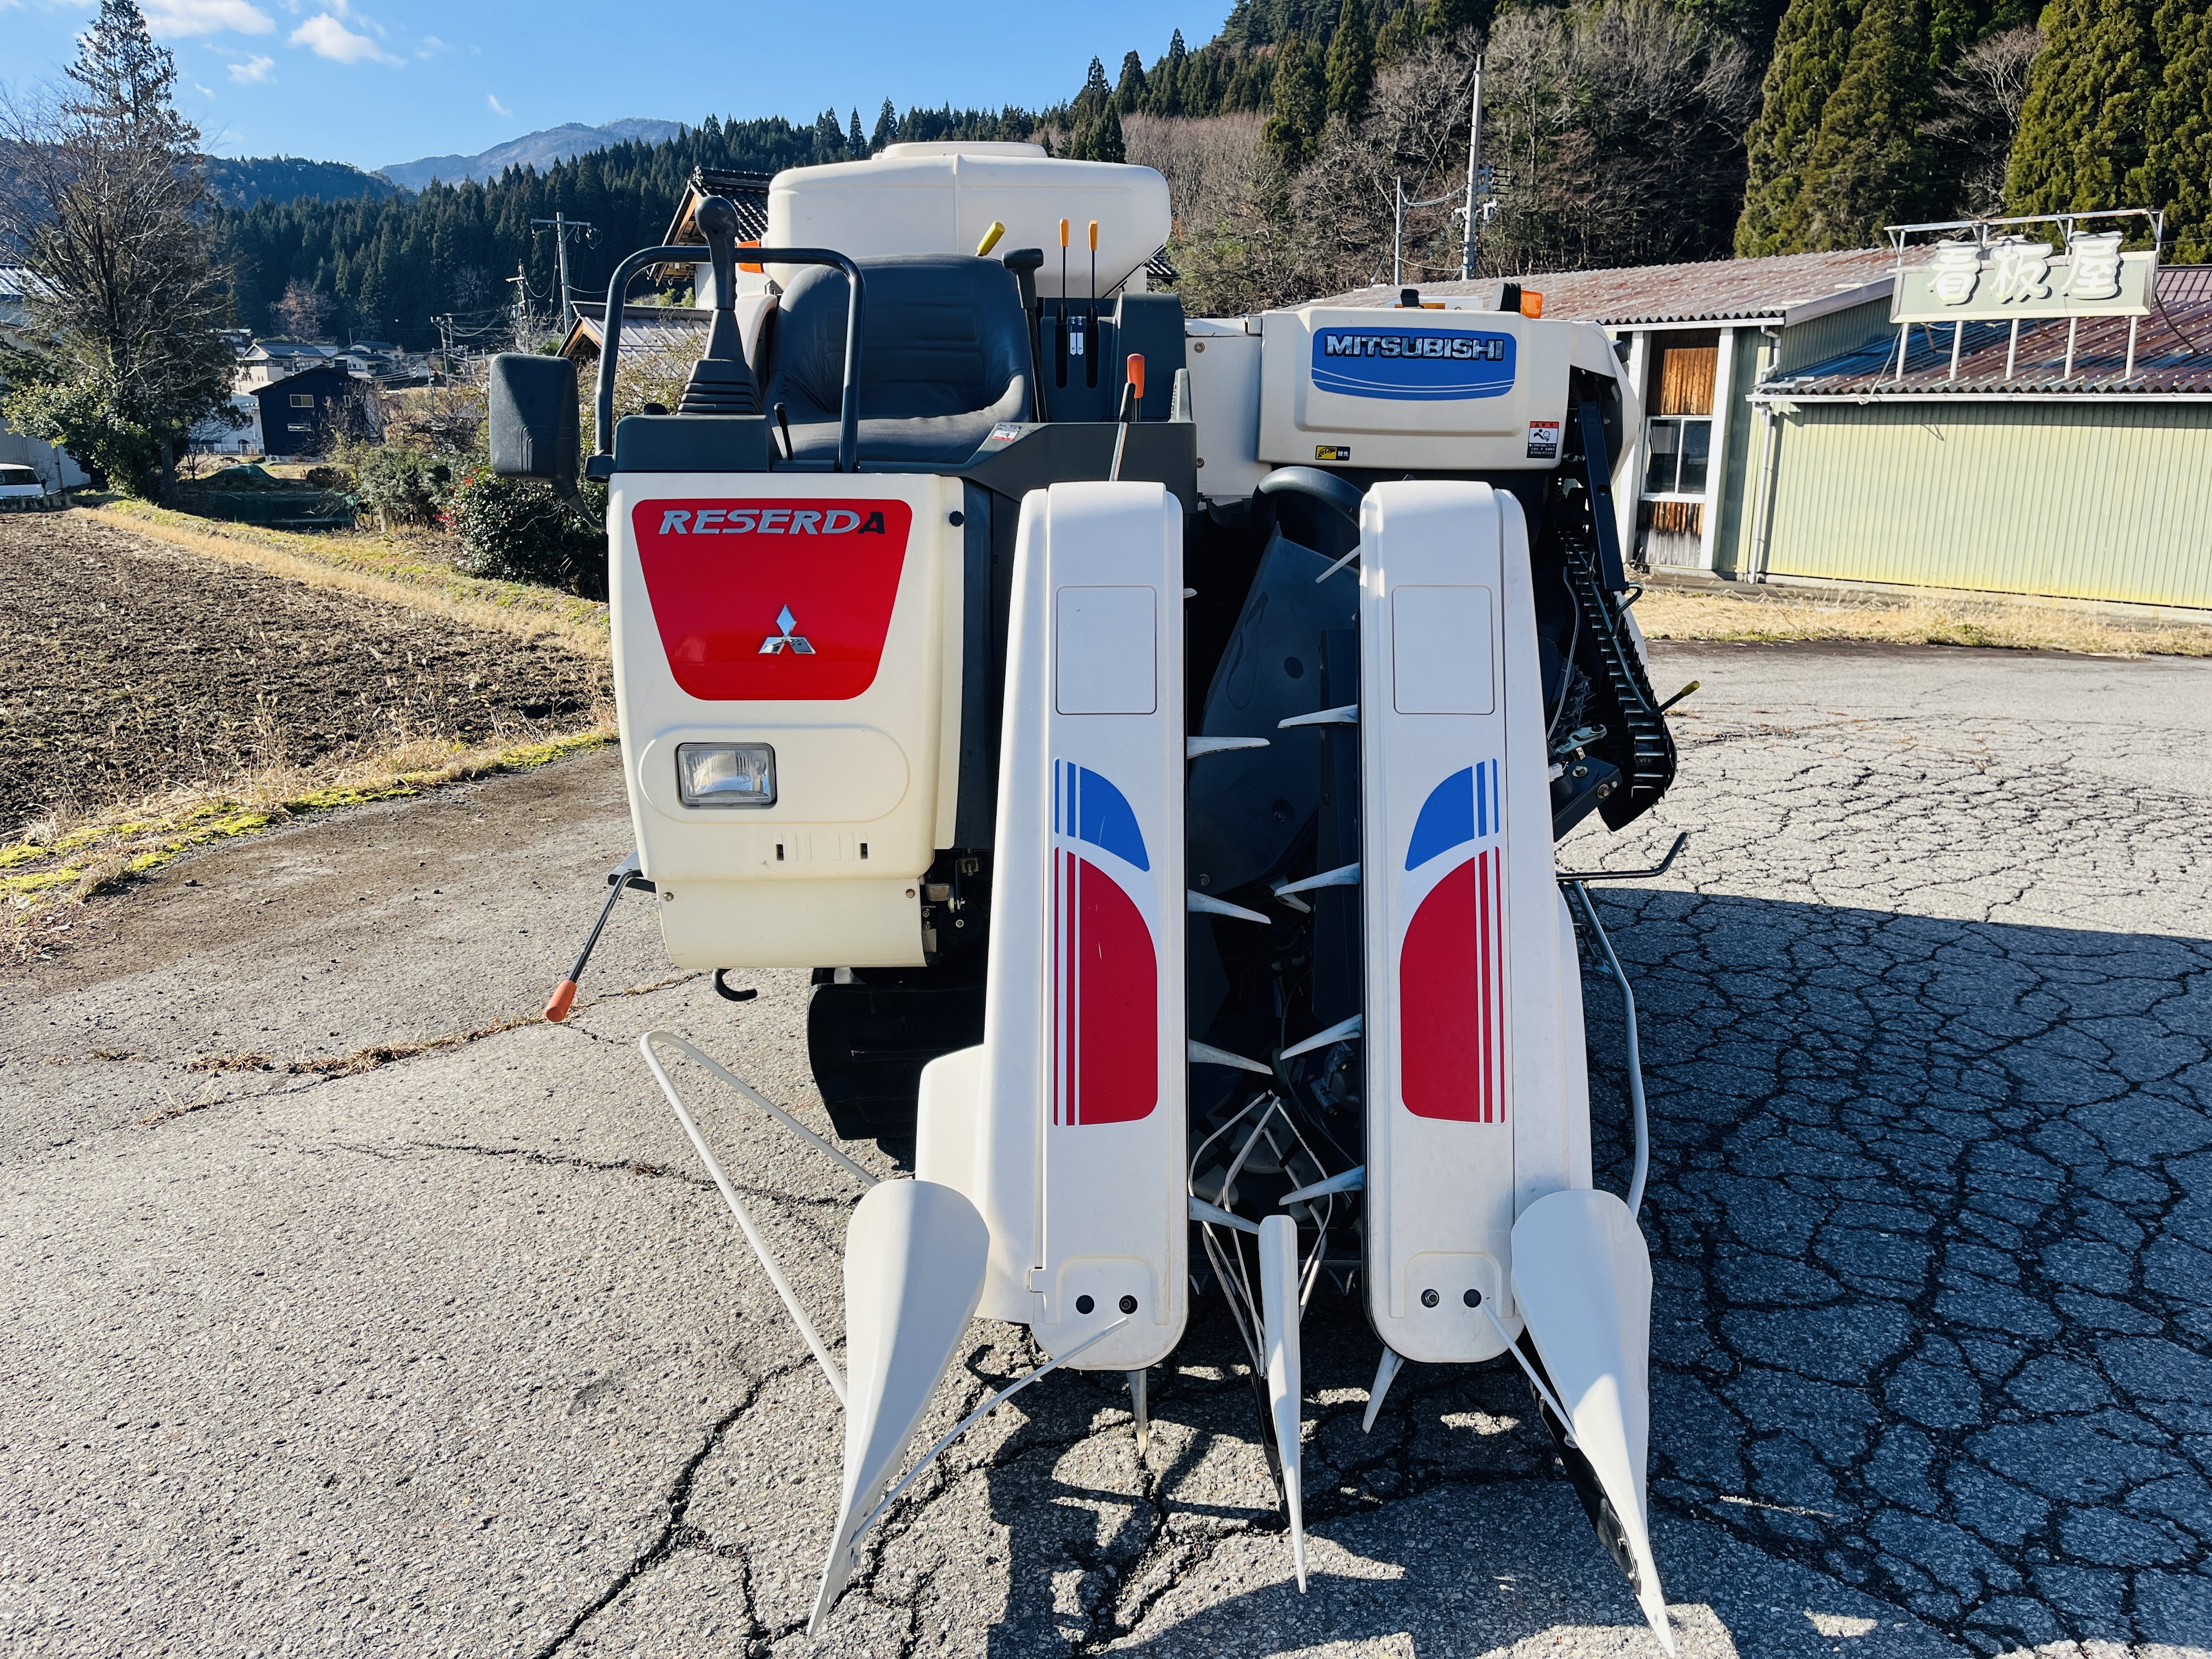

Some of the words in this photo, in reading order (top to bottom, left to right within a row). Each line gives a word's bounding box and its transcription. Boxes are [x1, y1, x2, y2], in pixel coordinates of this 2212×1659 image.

[1926, 231, 2123, 305] 看板屋
[1325, 335, 1505, 360] MITSUBISHI
[658, 509, 886, 535] RESERDA
